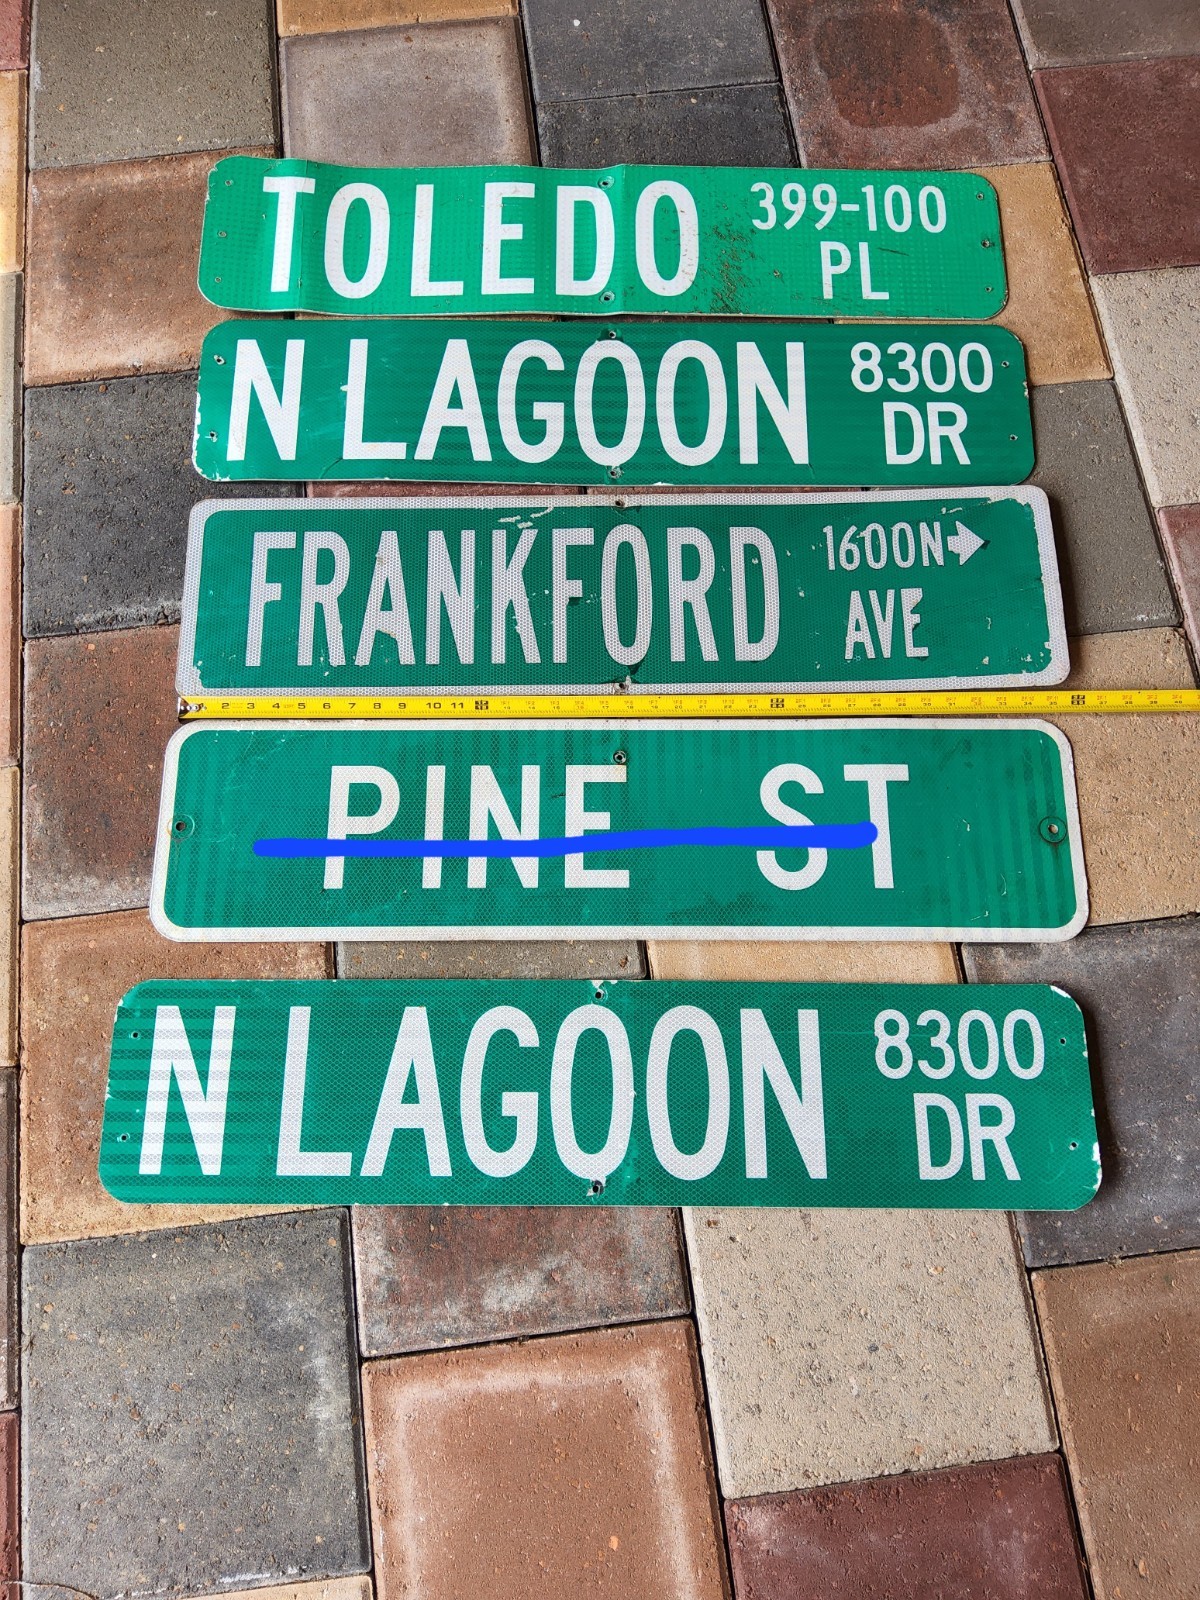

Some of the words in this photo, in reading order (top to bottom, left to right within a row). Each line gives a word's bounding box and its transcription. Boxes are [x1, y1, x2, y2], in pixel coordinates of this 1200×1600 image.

[262, 176, 699, 299] TOLEDO
[750, 181, 948, 233] 399-100
[819, 241, 890, 300] PL
[226, 338, 305, 462] N
[341, 338, 809, 467] LAGOON
[850, 341, 994, 394] 8300
[882, 401, 971, 466] DR
[822, 519, 946, 572] 1600N
[244, 523, 781, 667] FRANKFORD
[844, 587, 930, 661] AVE
[323, 764, 630, 890] PINE
[755, 763, 909, 891] ST
[873, 1008, 1045, 1080] 8300
[138, 1005, 236, 1176] N
[276, 1004, 828, 1184] LAGOON
[913, 1092, 1022, 1181] DR
